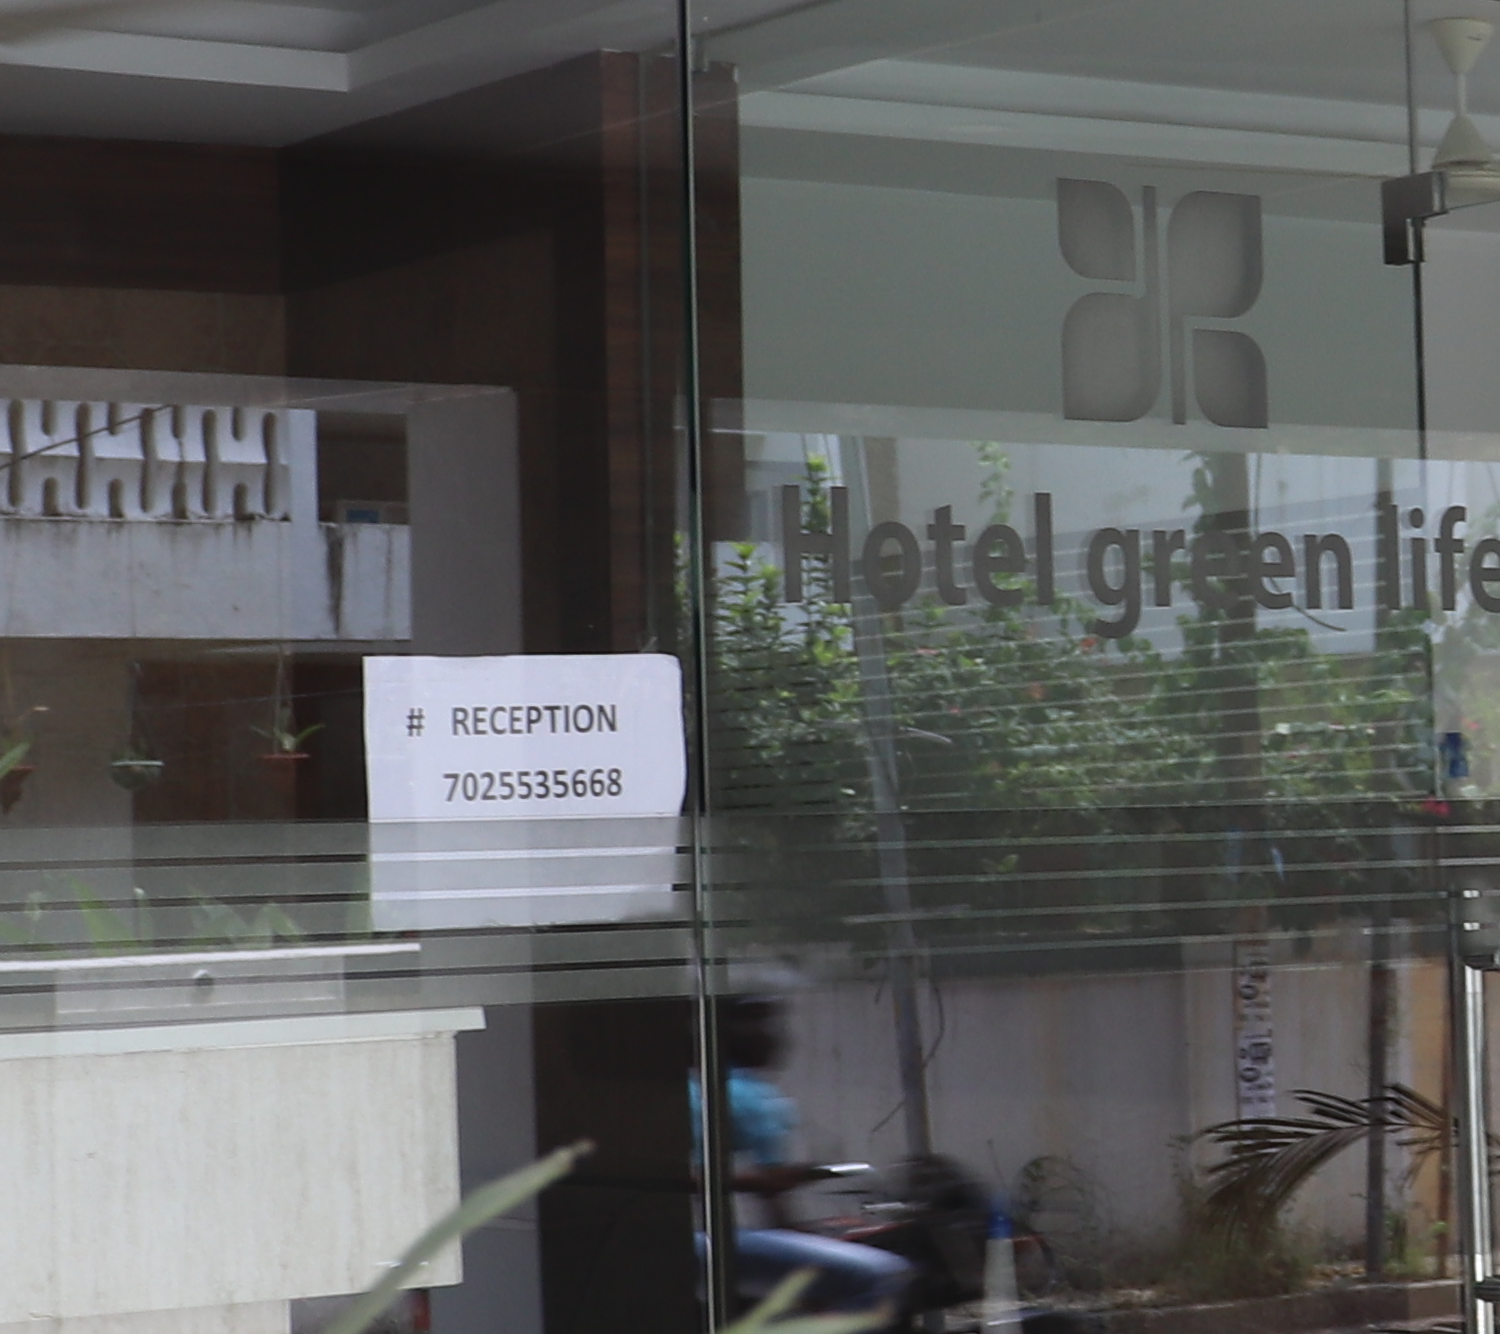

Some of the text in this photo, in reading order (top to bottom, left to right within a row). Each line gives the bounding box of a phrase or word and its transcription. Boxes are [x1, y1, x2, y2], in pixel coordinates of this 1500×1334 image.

[781, 483, 1054, 612] Hotel
[1086, 525, 1354, 640] green
[406, 703, 618, 737] # RECEPTION
[443, 768, 623, 802] 7025535668
